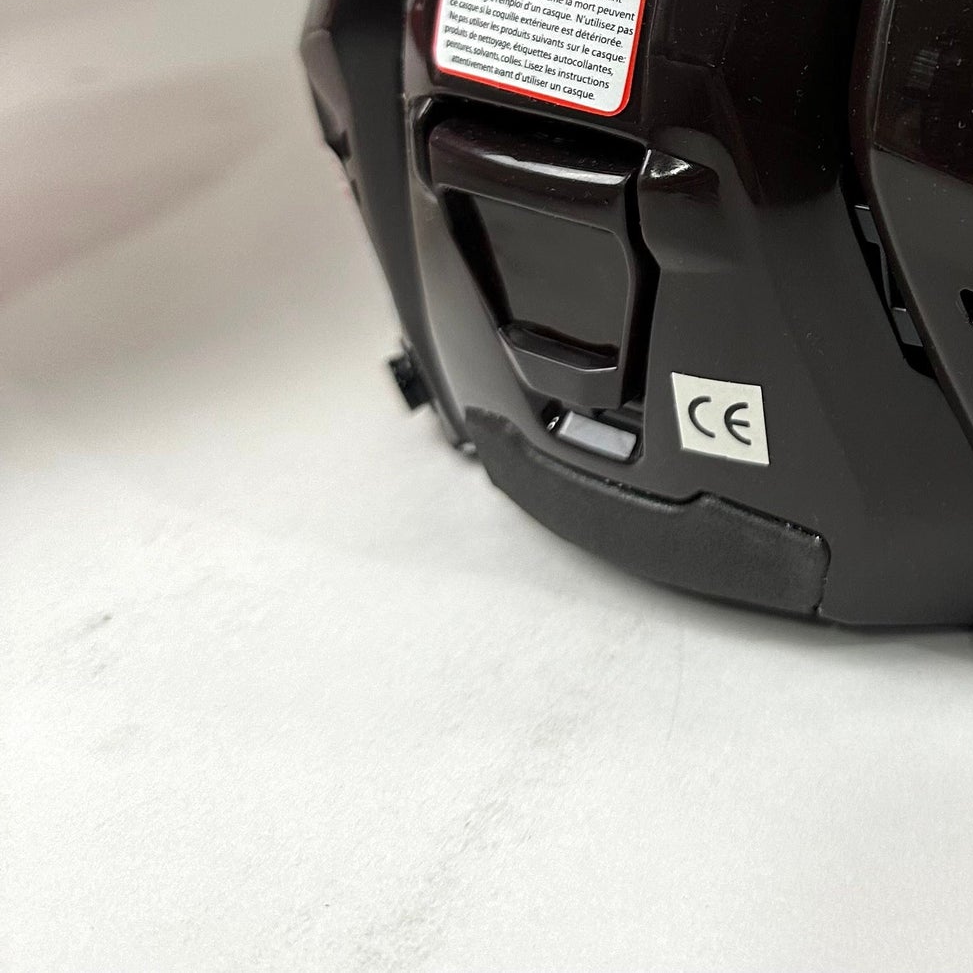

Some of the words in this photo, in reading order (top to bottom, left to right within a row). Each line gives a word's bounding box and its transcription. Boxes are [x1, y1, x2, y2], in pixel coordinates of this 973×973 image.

[523, 1, 541, 12] d'un
[575, 13, 615, 31] N'utilisez
[616, 25, 634, 35] pas
[573, 0, 596, 11] mort
[596, 6, 636, 21] peuvent
[500, 26, 531, 39] produits
[531, 34, 565, 48] suivants
[566, 43, 581, 51] sur
[520, 16, 559, 32] extérieure
[560, 27, 574, 35] est
[574, 29, 624, 47] détériorée.
[500, 54, 522, 66] colles.
[524, 59, 543, 72] Lisez
[544, 64, 556, 75] les
[557, 68, 610, 88] instructions
[512, 42, 552, 59] étiquettes
[552, 54, 613, 76] autocollantes,
[514, 71, 548, 87] d'utiliser
[688, 395, 752, 446] CE
